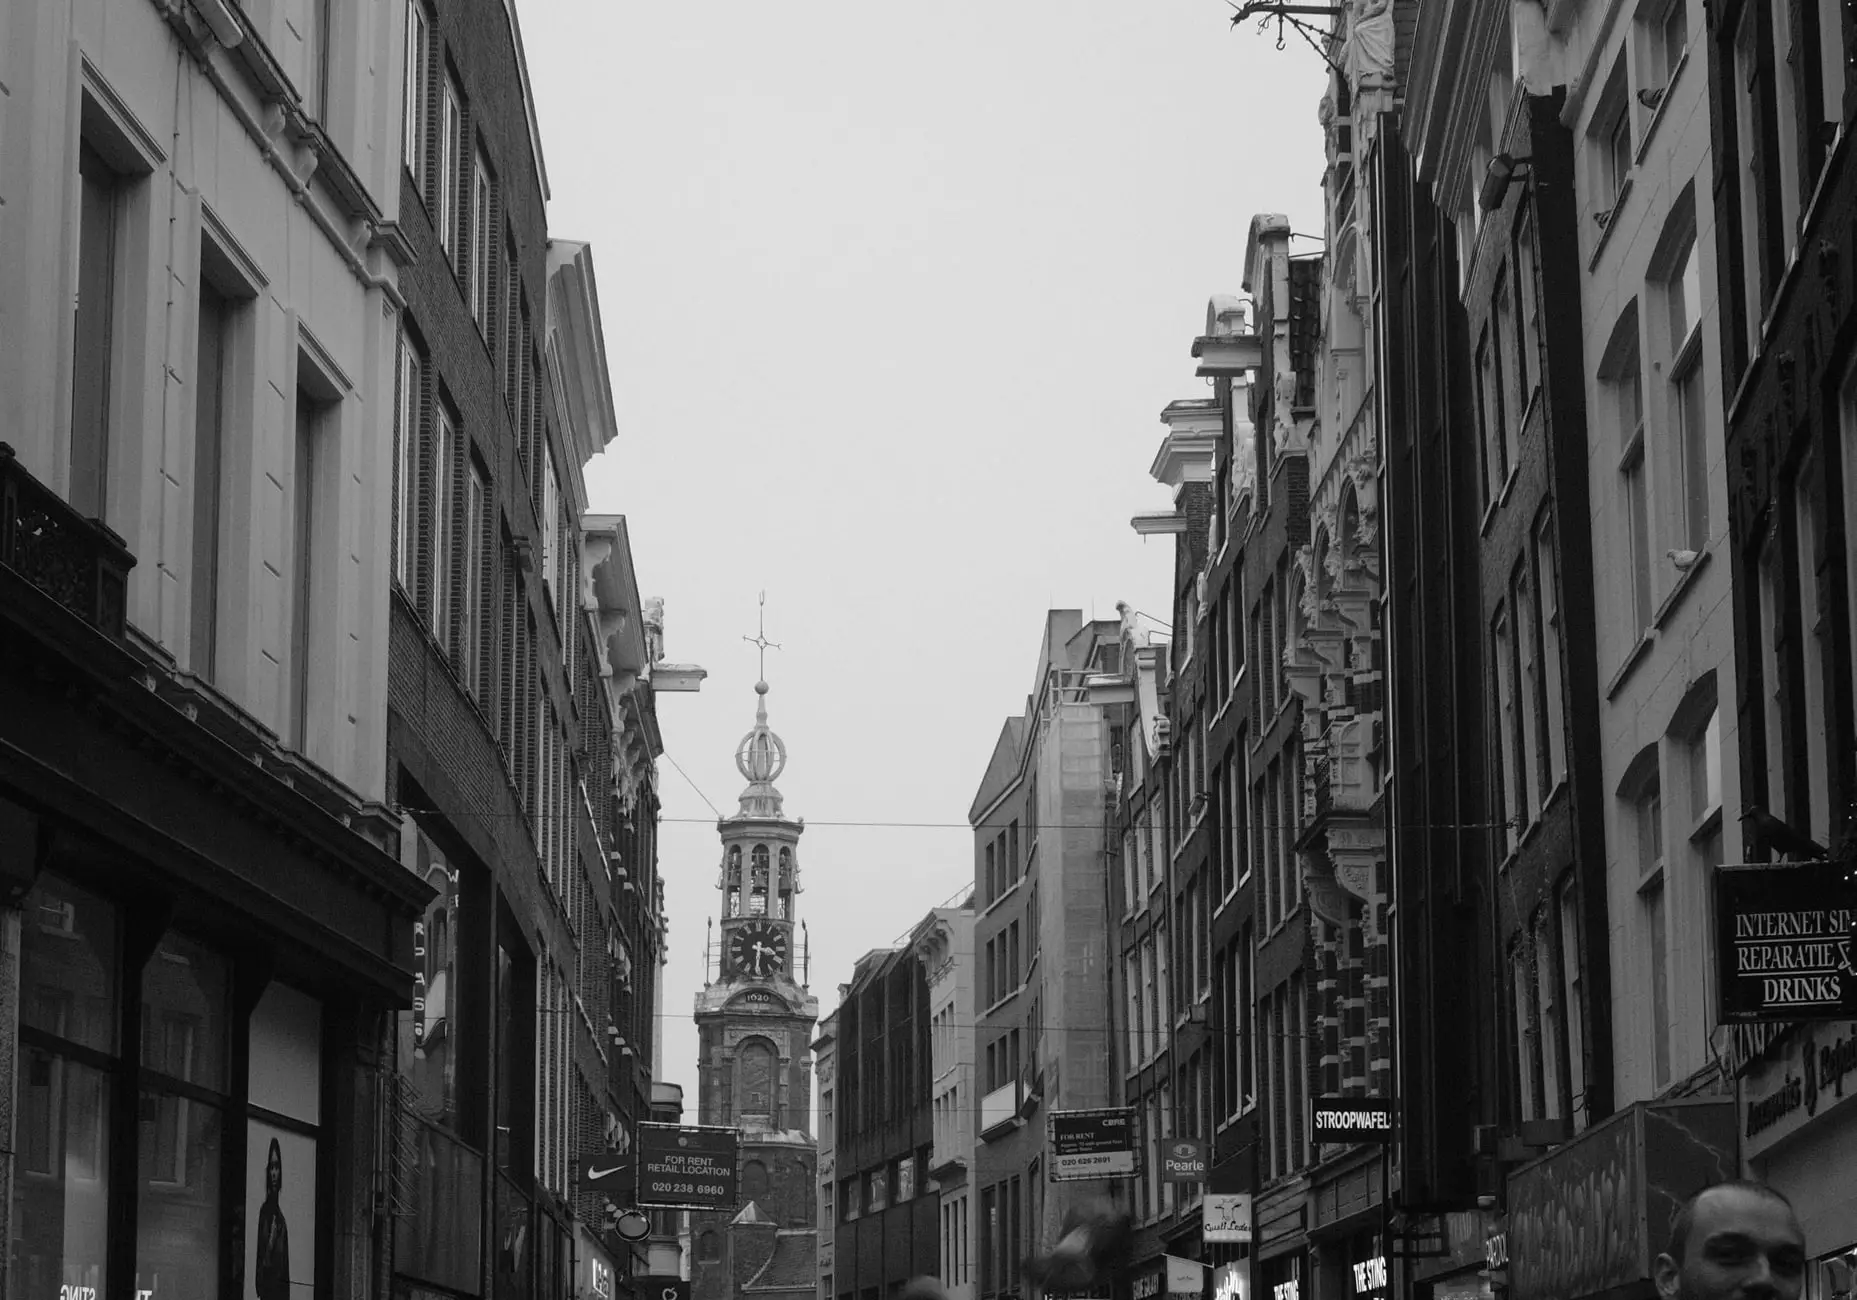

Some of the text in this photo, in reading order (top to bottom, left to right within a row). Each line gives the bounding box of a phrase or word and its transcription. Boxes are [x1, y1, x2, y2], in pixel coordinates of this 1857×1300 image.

[1736, 910, 1825, 938] INTERNET
[1737, 943, 1835, 972] REPARATIE
[1763, 975, 1842, 1003] DRINKS
[648, 1163, 730, 1176] RETAIL LOCATION
[664, 1155, 714, 1166] FOR RENT
[1166, 1159, 1204, 1171] Pearle
[652, 1182, 724, 1195] 020 238 6960
[1353, 1255, 1388, 1294] THE STING
